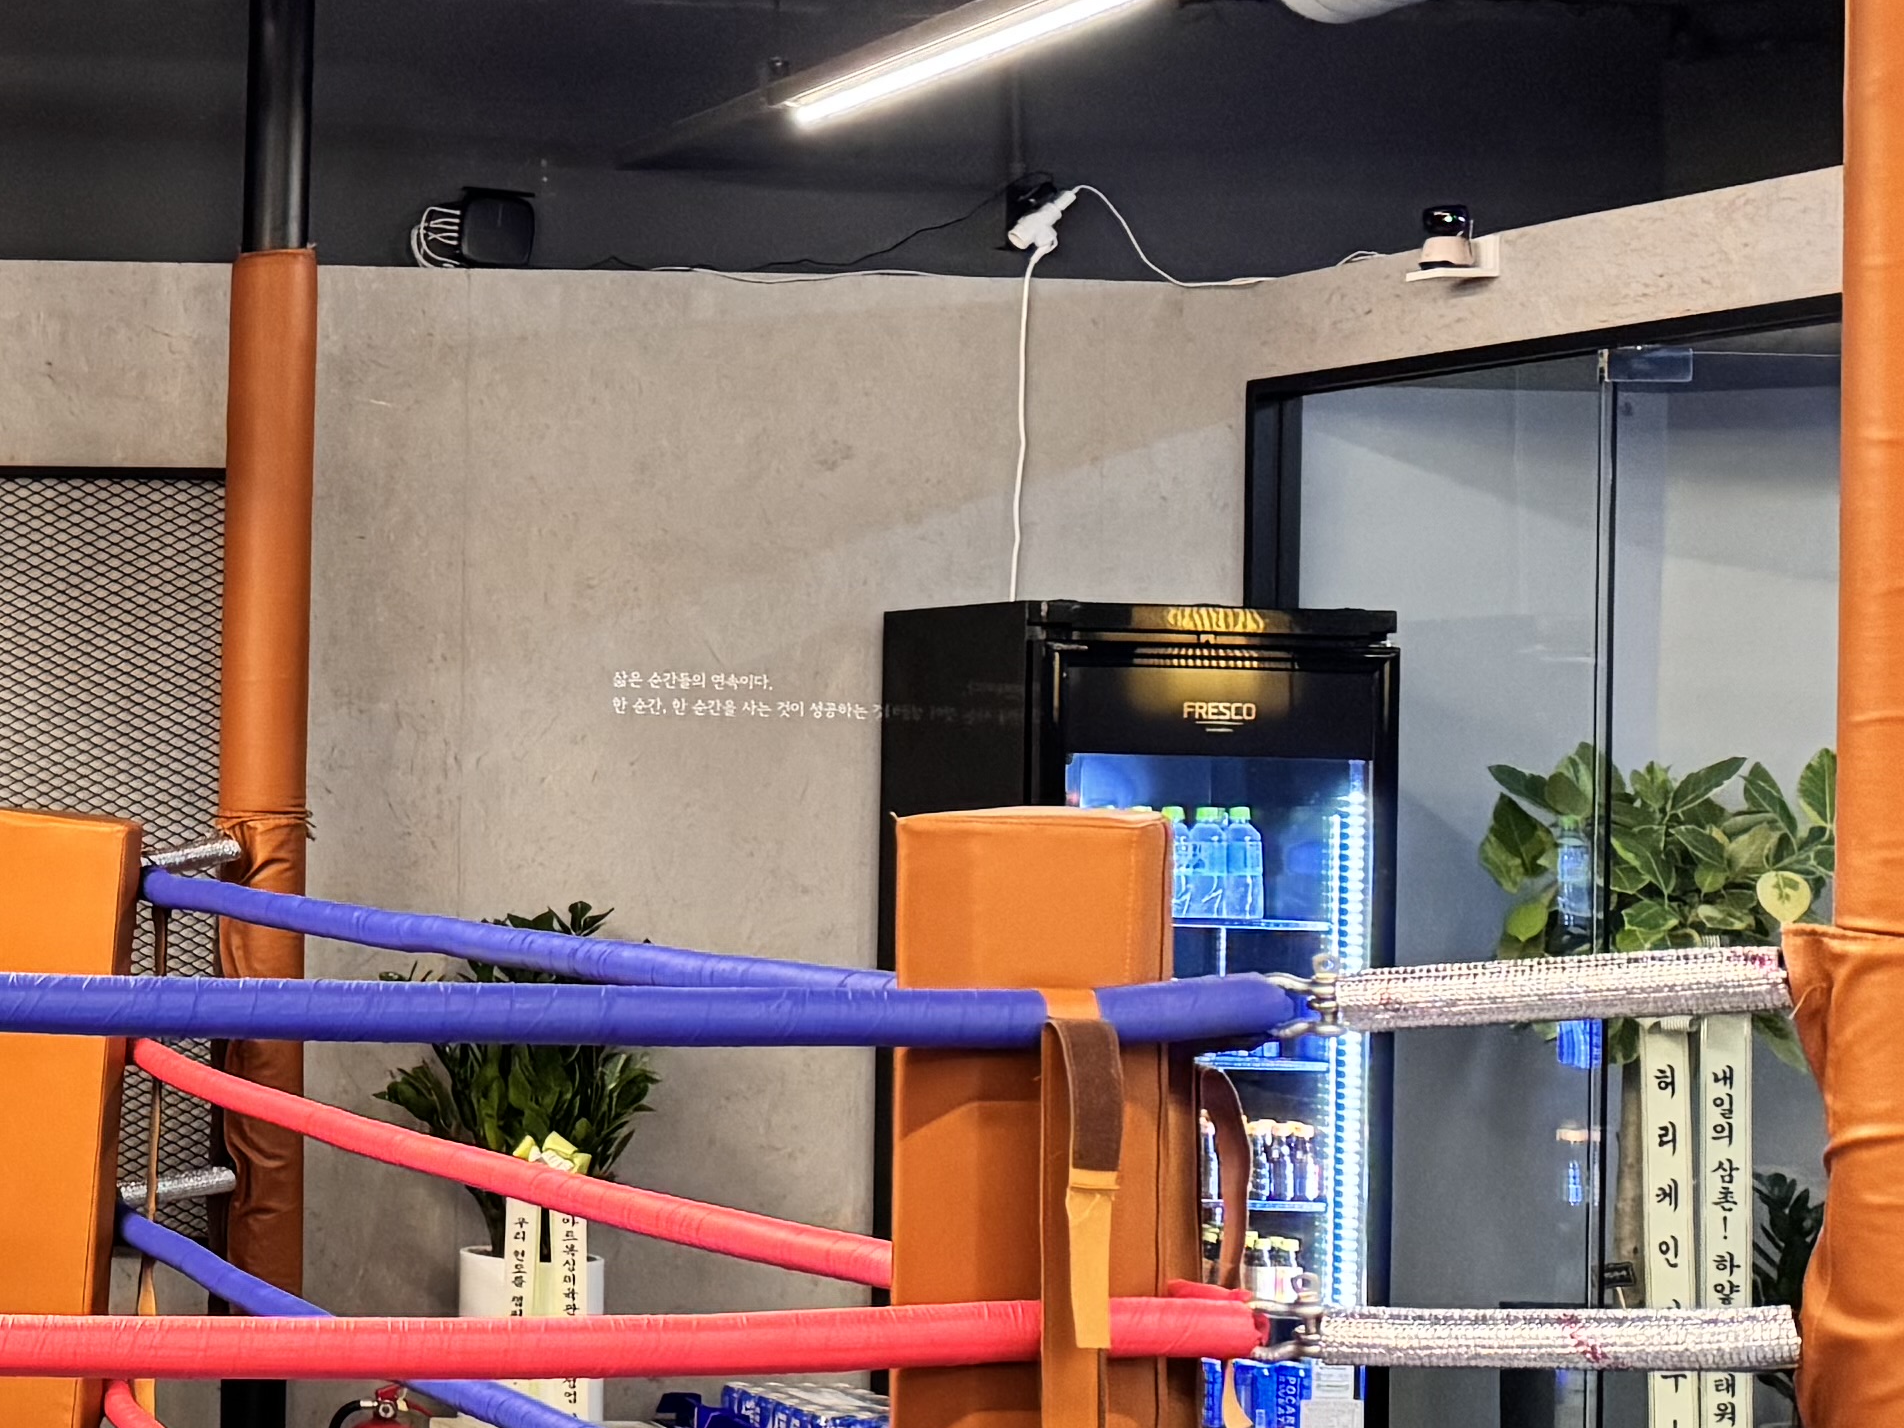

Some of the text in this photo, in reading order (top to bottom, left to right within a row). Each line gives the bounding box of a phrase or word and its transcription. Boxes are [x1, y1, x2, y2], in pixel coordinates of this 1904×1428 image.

[613, 670, 774, 691] 삶은 순간들의 연속이다.
[612, 696, 628, 715] 한
[632, 697, 667, 715] 순간,
[672, 698, 689, 716] 한
[692, 698, 737, 717] 순간을
[742, 699, 773, 718] 사는
[776, 700, 805, 719] 것이
[809, 701, 869, 720] 성공하는
[1182, 701, 1257, 721] FRESCO
[1711, 1064, 1735, 1148] 내일의
[1711, 1158, 1740, 1241] 삼촌!
[1712, 1251, 1742, 1307] 하얗
